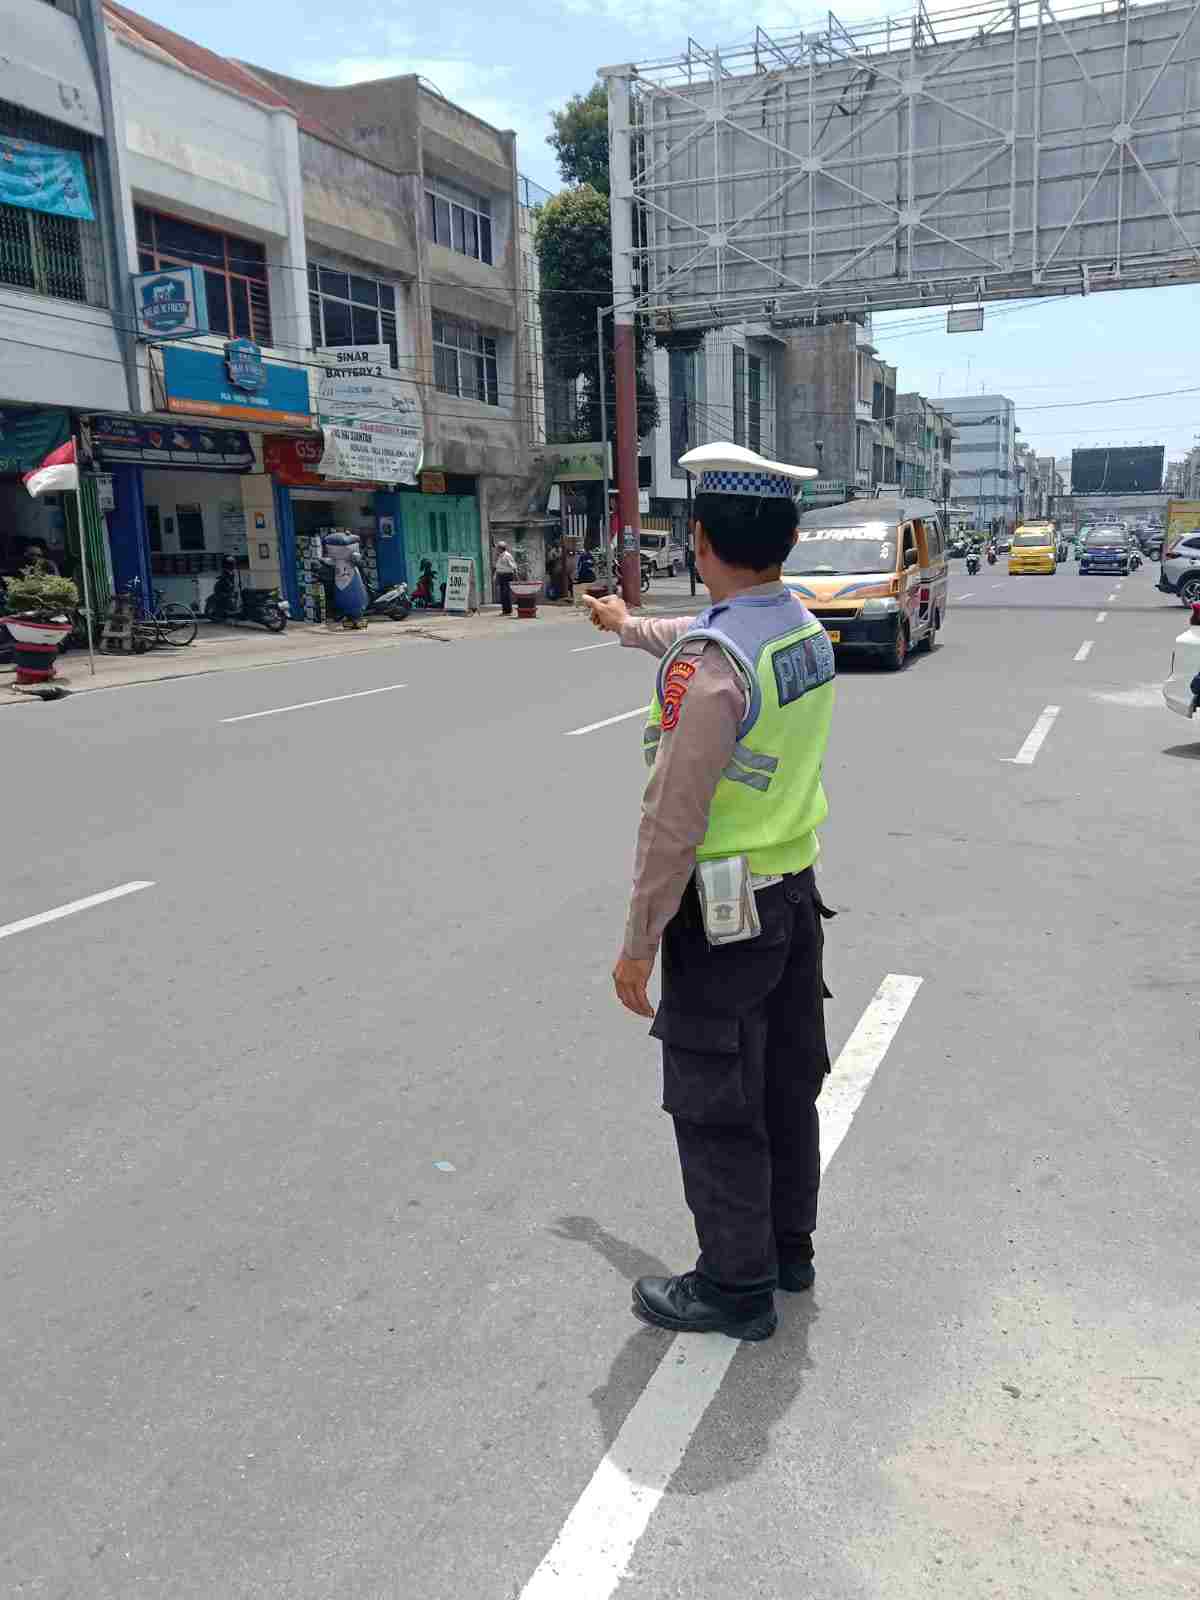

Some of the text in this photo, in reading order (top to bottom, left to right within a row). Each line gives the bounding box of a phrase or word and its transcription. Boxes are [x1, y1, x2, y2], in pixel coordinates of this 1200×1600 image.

[336, 351, 369, 363] SINAR
[326, 366, 382, 379] BATTERY 2
